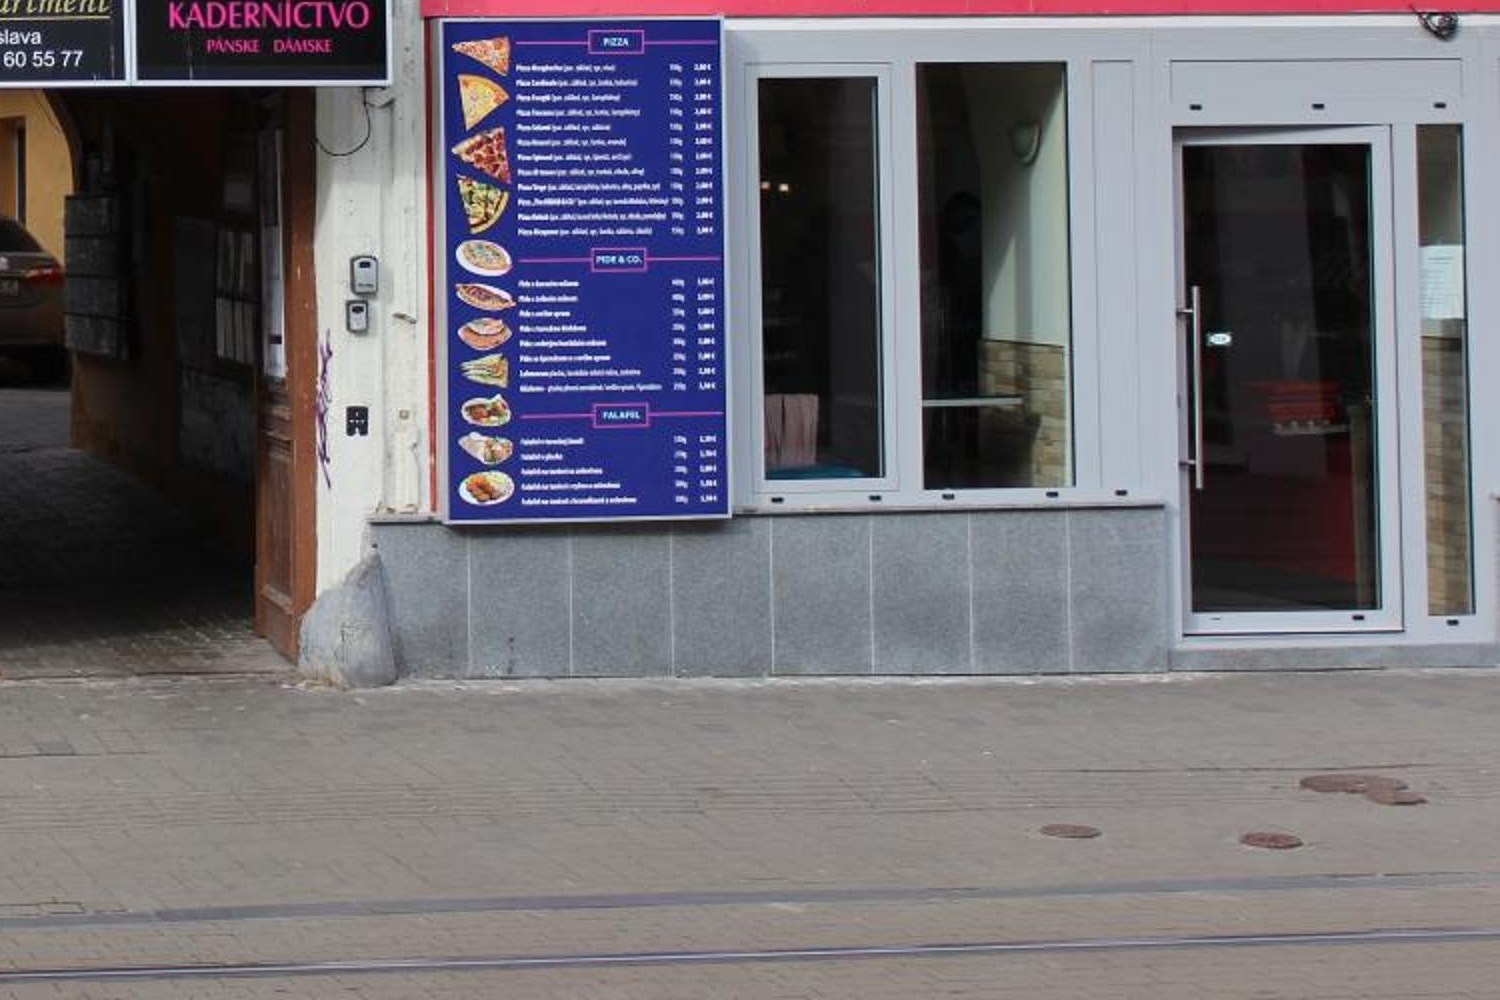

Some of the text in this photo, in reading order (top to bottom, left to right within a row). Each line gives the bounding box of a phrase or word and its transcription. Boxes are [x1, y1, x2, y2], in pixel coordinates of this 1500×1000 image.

[3, 51, 27, 68] 60
[32, 51, 55, 67] 55
[61, 50, 83, 67] 77
